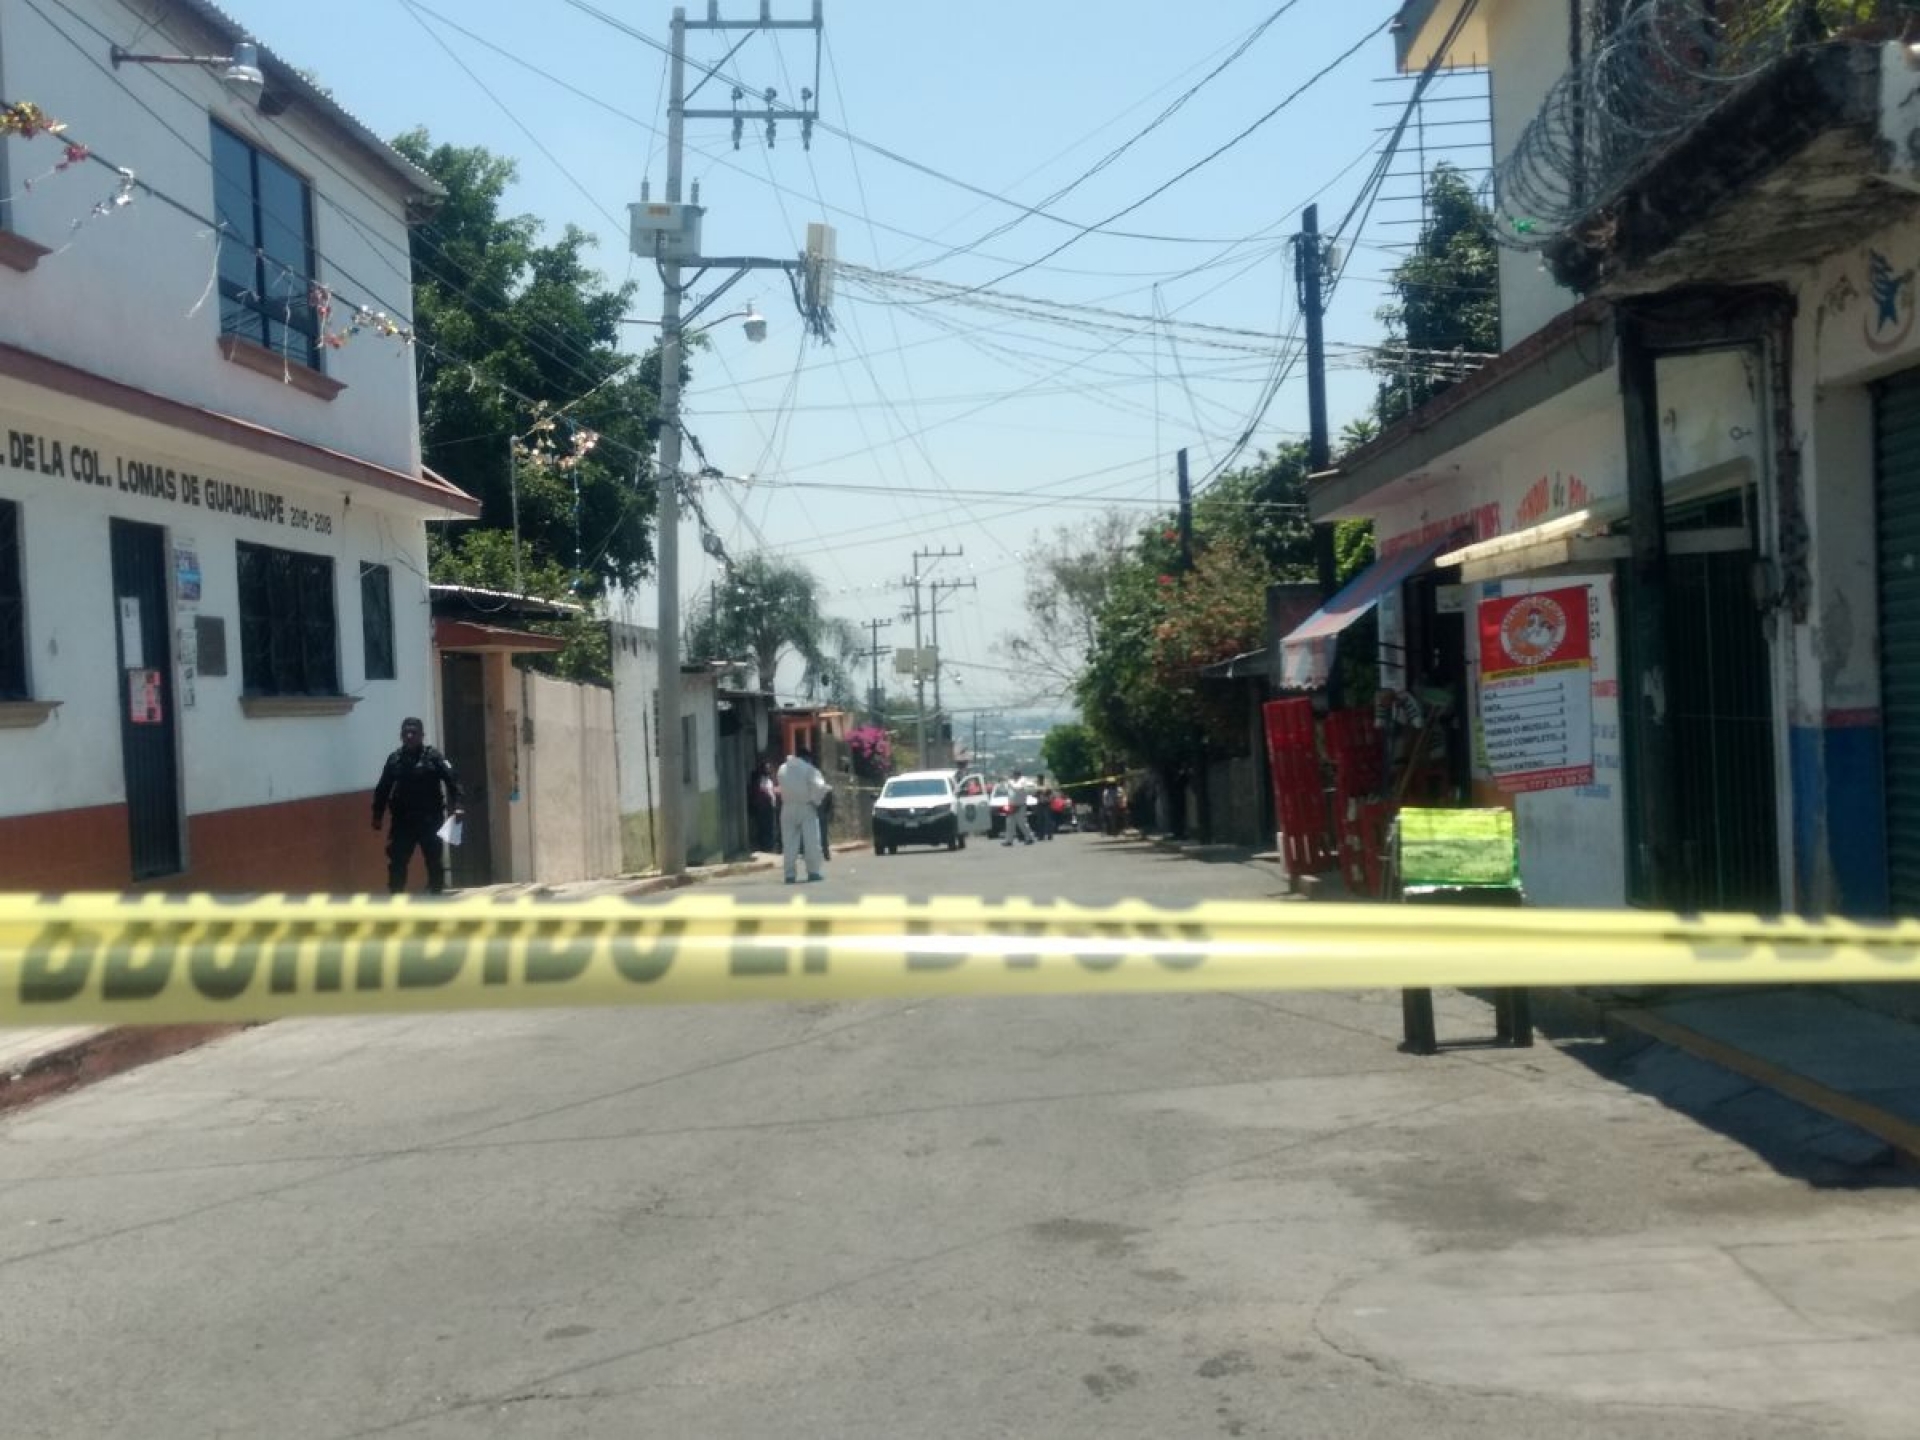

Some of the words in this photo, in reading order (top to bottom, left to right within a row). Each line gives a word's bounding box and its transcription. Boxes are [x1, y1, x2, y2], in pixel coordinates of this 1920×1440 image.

[9, 429, 35, 471] DE
[38, 437, 65, 478] LA
[70, 445, 112, 487] COL.
[117, 457, 177, 502] LOMAS
[181, 476, 200, 506] DE
[204, 478, 285, 525] GUADALUPE
